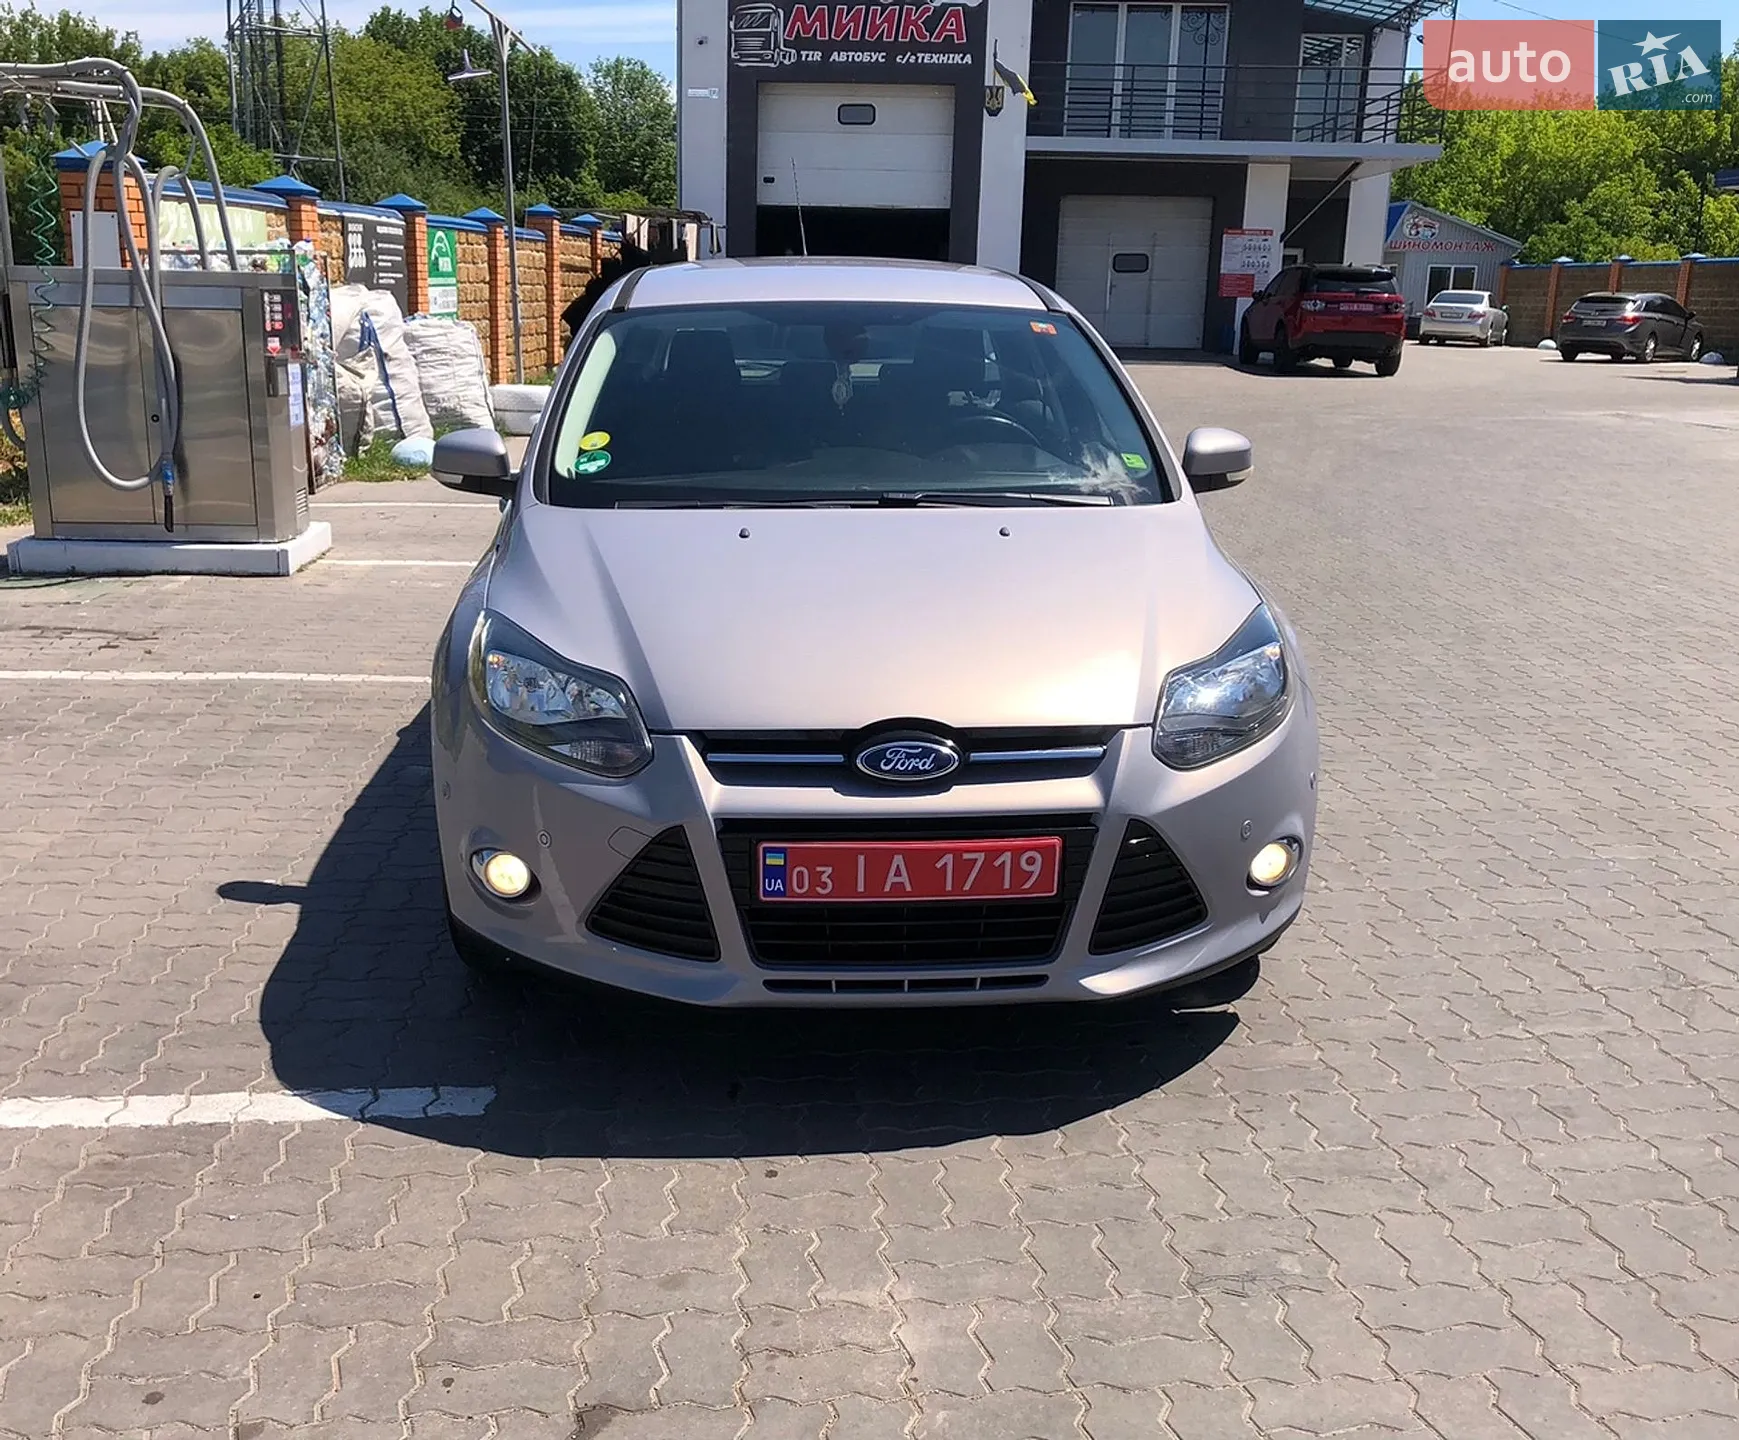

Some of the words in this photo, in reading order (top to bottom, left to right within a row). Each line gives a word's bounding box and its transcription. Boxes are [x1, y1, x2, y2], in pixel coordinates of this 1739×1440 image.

[800, 51, 822, 62] TIR
[829, 51, 887, 63] АВТОБУС
[1388, 239, 1497, 253] ШИНОМОНТАЖ
[879, 746, 936, 772] Ford
[791, 866, 835, 894] 03
[934, 851, 1043, 891] 1719
[765, 879, 784, 892] UA
